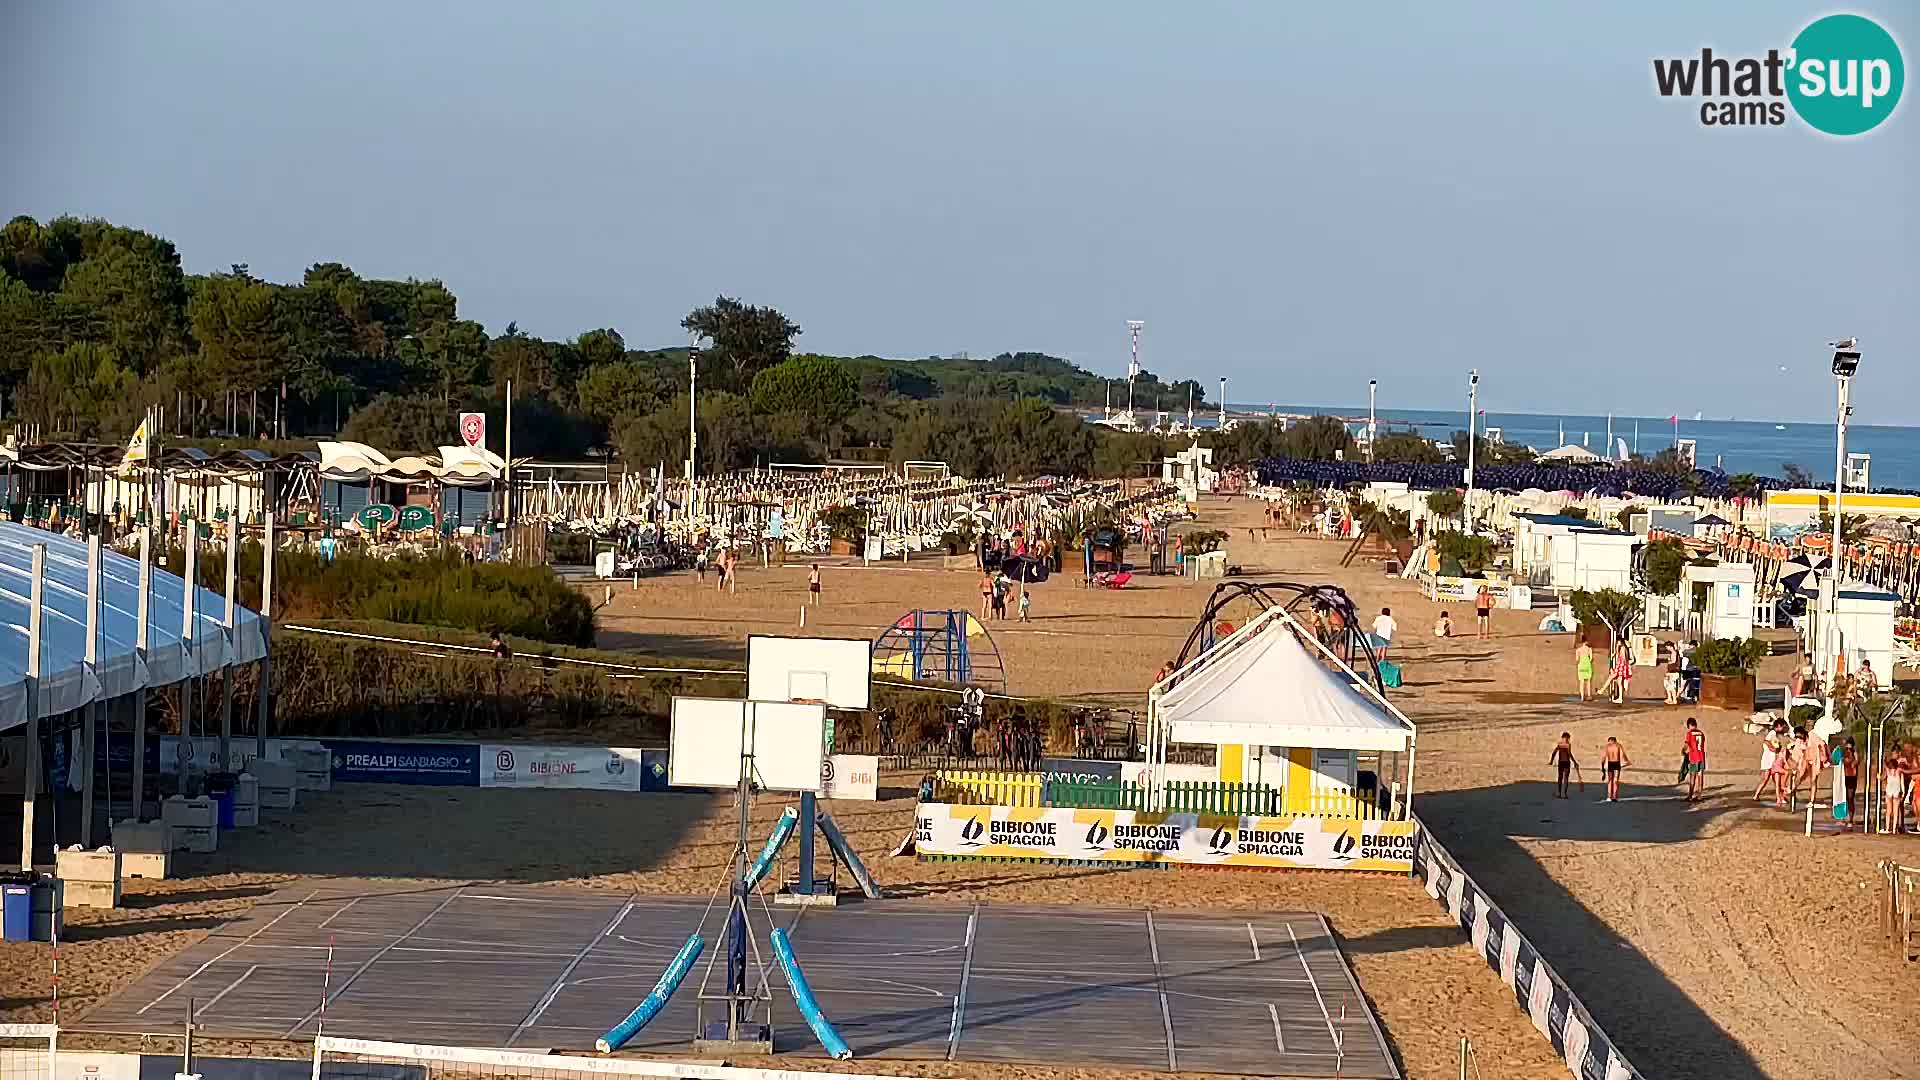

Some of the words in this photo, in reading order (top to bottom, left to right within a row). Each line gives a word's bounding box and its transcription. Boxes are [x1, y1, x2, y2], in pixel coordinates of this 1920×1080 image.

[530, 761, 578, 775] BIBIONE
[990, 820, 1057, 835] BIBIONE
[1114, 825, 1181, 840] BIBIONE
[990, 834, 1056, 847] SPIAGGIA
[1113, 838, 1180, 851] SPIAGGIA
[1238, 830, 1305, 845] BIBIONE
[1237, 843, 1304, 856] SPIAGGIA
